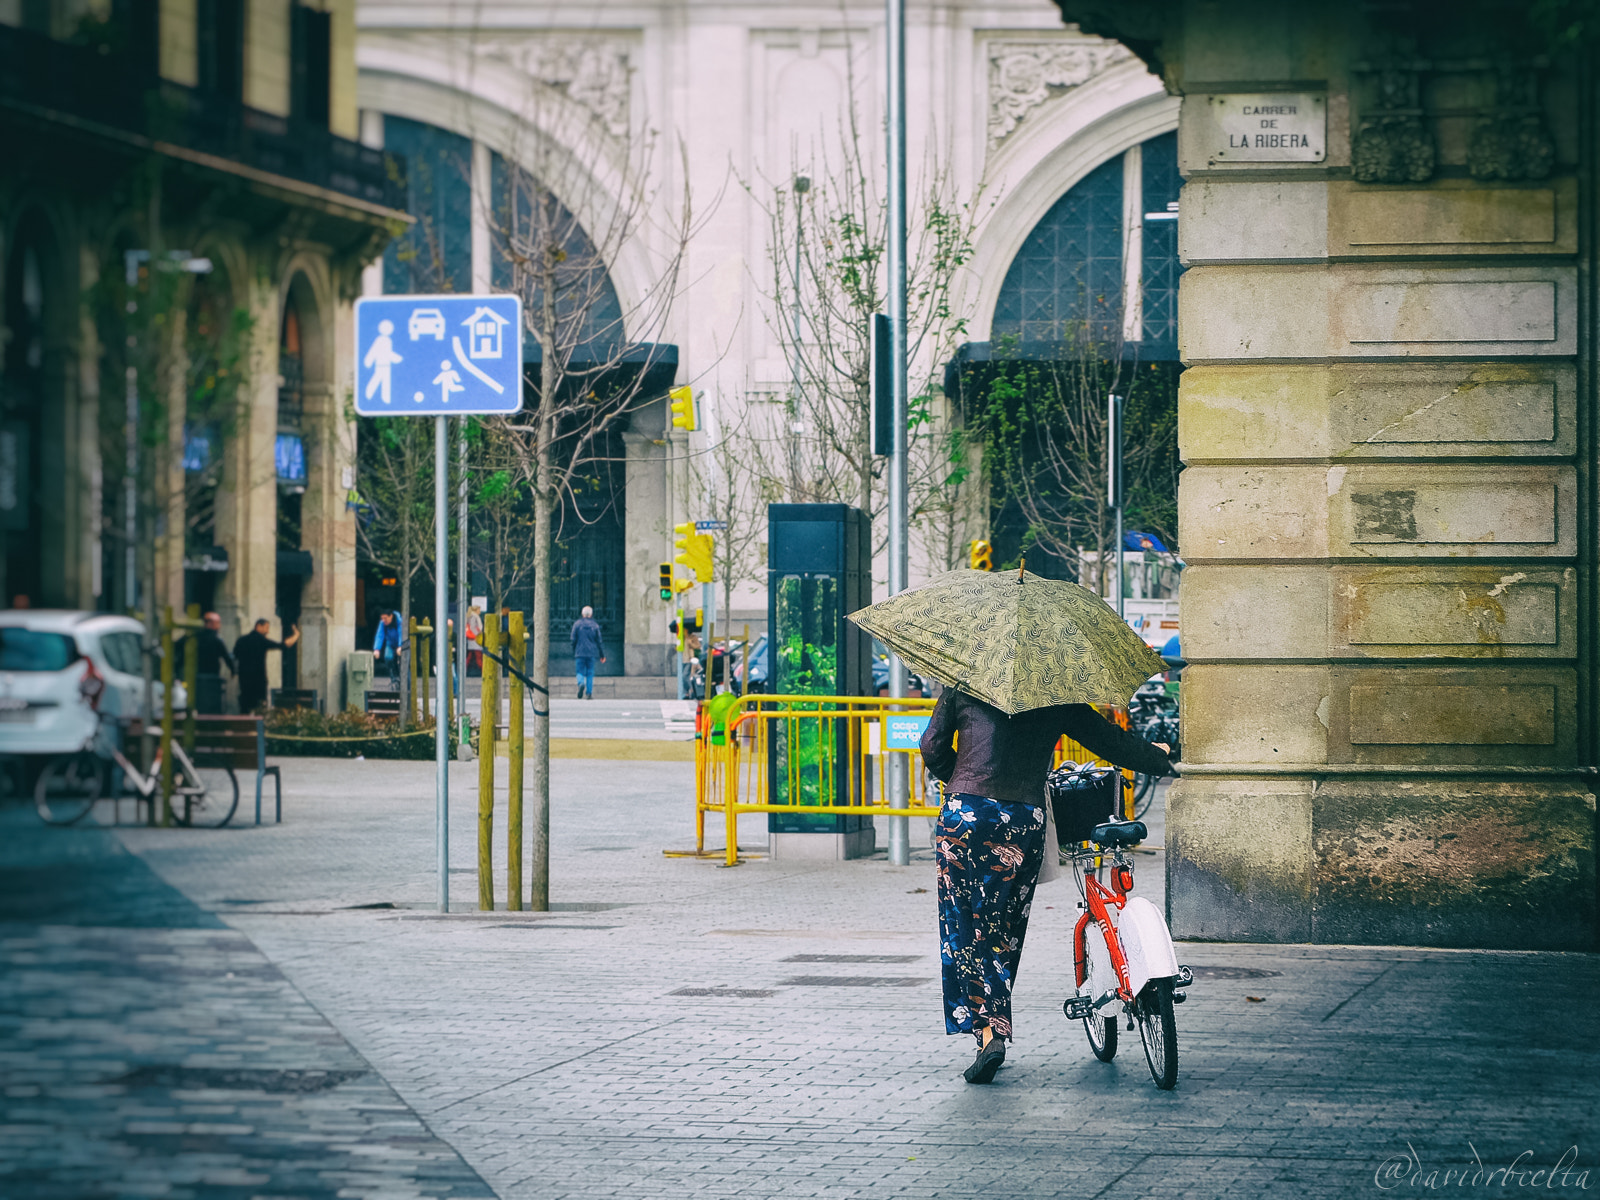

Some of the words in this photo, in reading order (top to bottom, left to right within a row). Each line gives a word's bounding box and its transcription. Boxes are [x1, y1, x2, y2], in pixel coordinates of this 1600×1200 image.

[1243, 106, 1297, 115] CARRER
[1261, 120, 1278, 129] DE
[1230, 134, 1249, 148] LA
[1255, 134, 1309, 148] RIBERA
